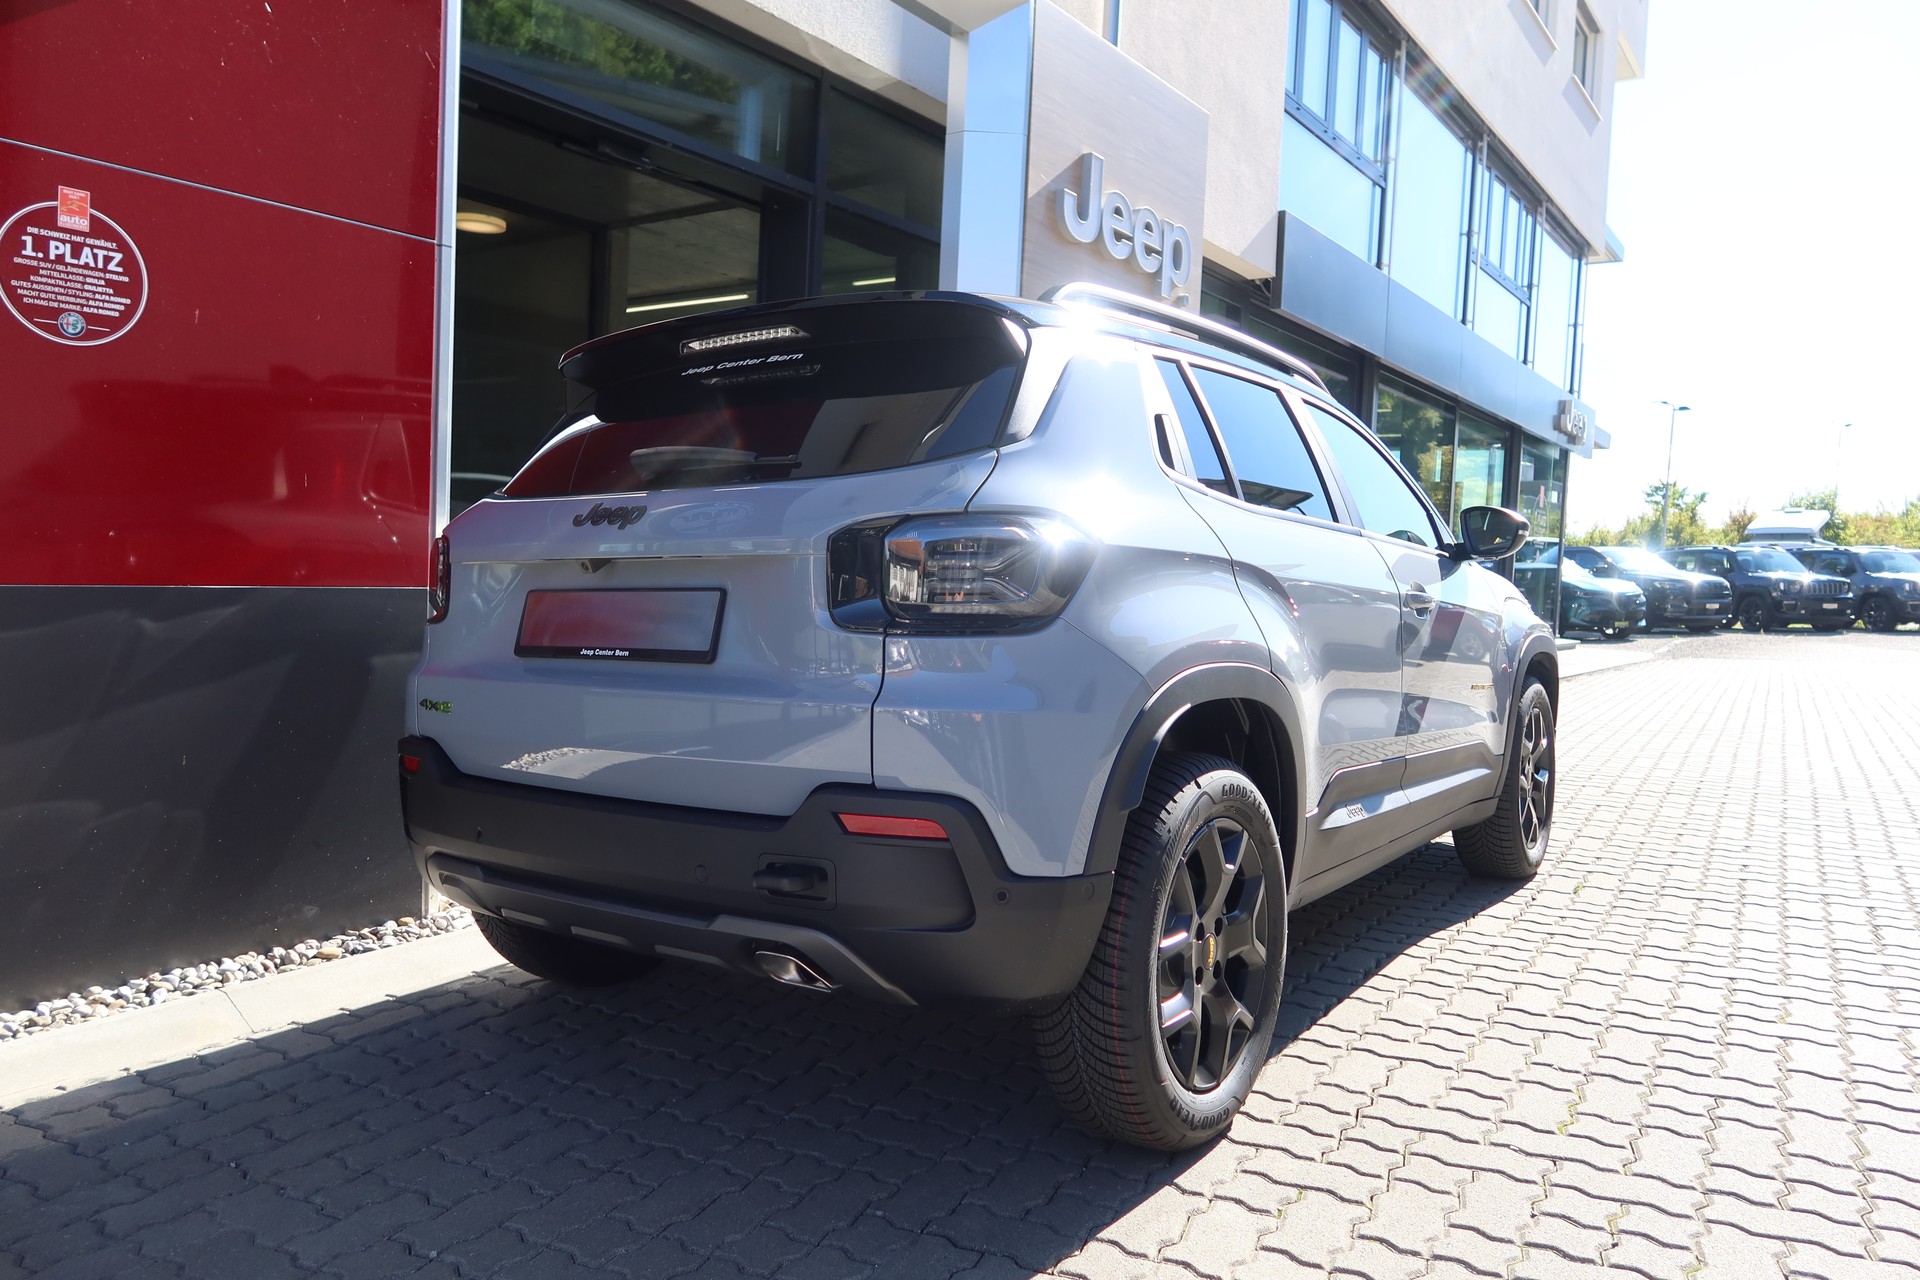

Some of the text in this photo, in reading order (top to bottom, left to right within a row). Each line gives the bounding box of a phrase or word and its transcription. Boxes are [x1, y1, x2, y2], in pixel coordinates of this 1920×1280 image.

[60, 214, 88, 226] auto
[1056, 152, 1192, 299] Jeep
[27, 226, 39, 235] DIE
[39, 229, 71, 240] SCHWEIZ
[71, 234, 85, 242] HAT
[21, 235, 124, 272] 1. PLATZ
[13, 257, 38, 267] GROSSE
[39, 261, 52, 269] SUV
[105, 273, 129, 282] STELVIO
[85, 277, 106, 285] GIULIA
[11, 280, 31, 288] GUTES
[32, 283, 65, 294] AUSSEHEN
[94, 293, 109, 301] ALFA
[109, 296, 131, 304] ROMEO
[17, 288, 39, 296] MACHT
[39, 292, 56, 300] GUTE
[103, 302, 125, 310] ROMEO
[82, 306, 98, 314] ALFA
[98, 309, 120, 317] ROMEO
[681, 353, 804, 376] Jeep Center Bern
[572, 502, 648, 530] Jeep
[580, 648, 629, 657] Jeep Center Bern
[1169, 1094, 1230, 1131] GOODYEAR
